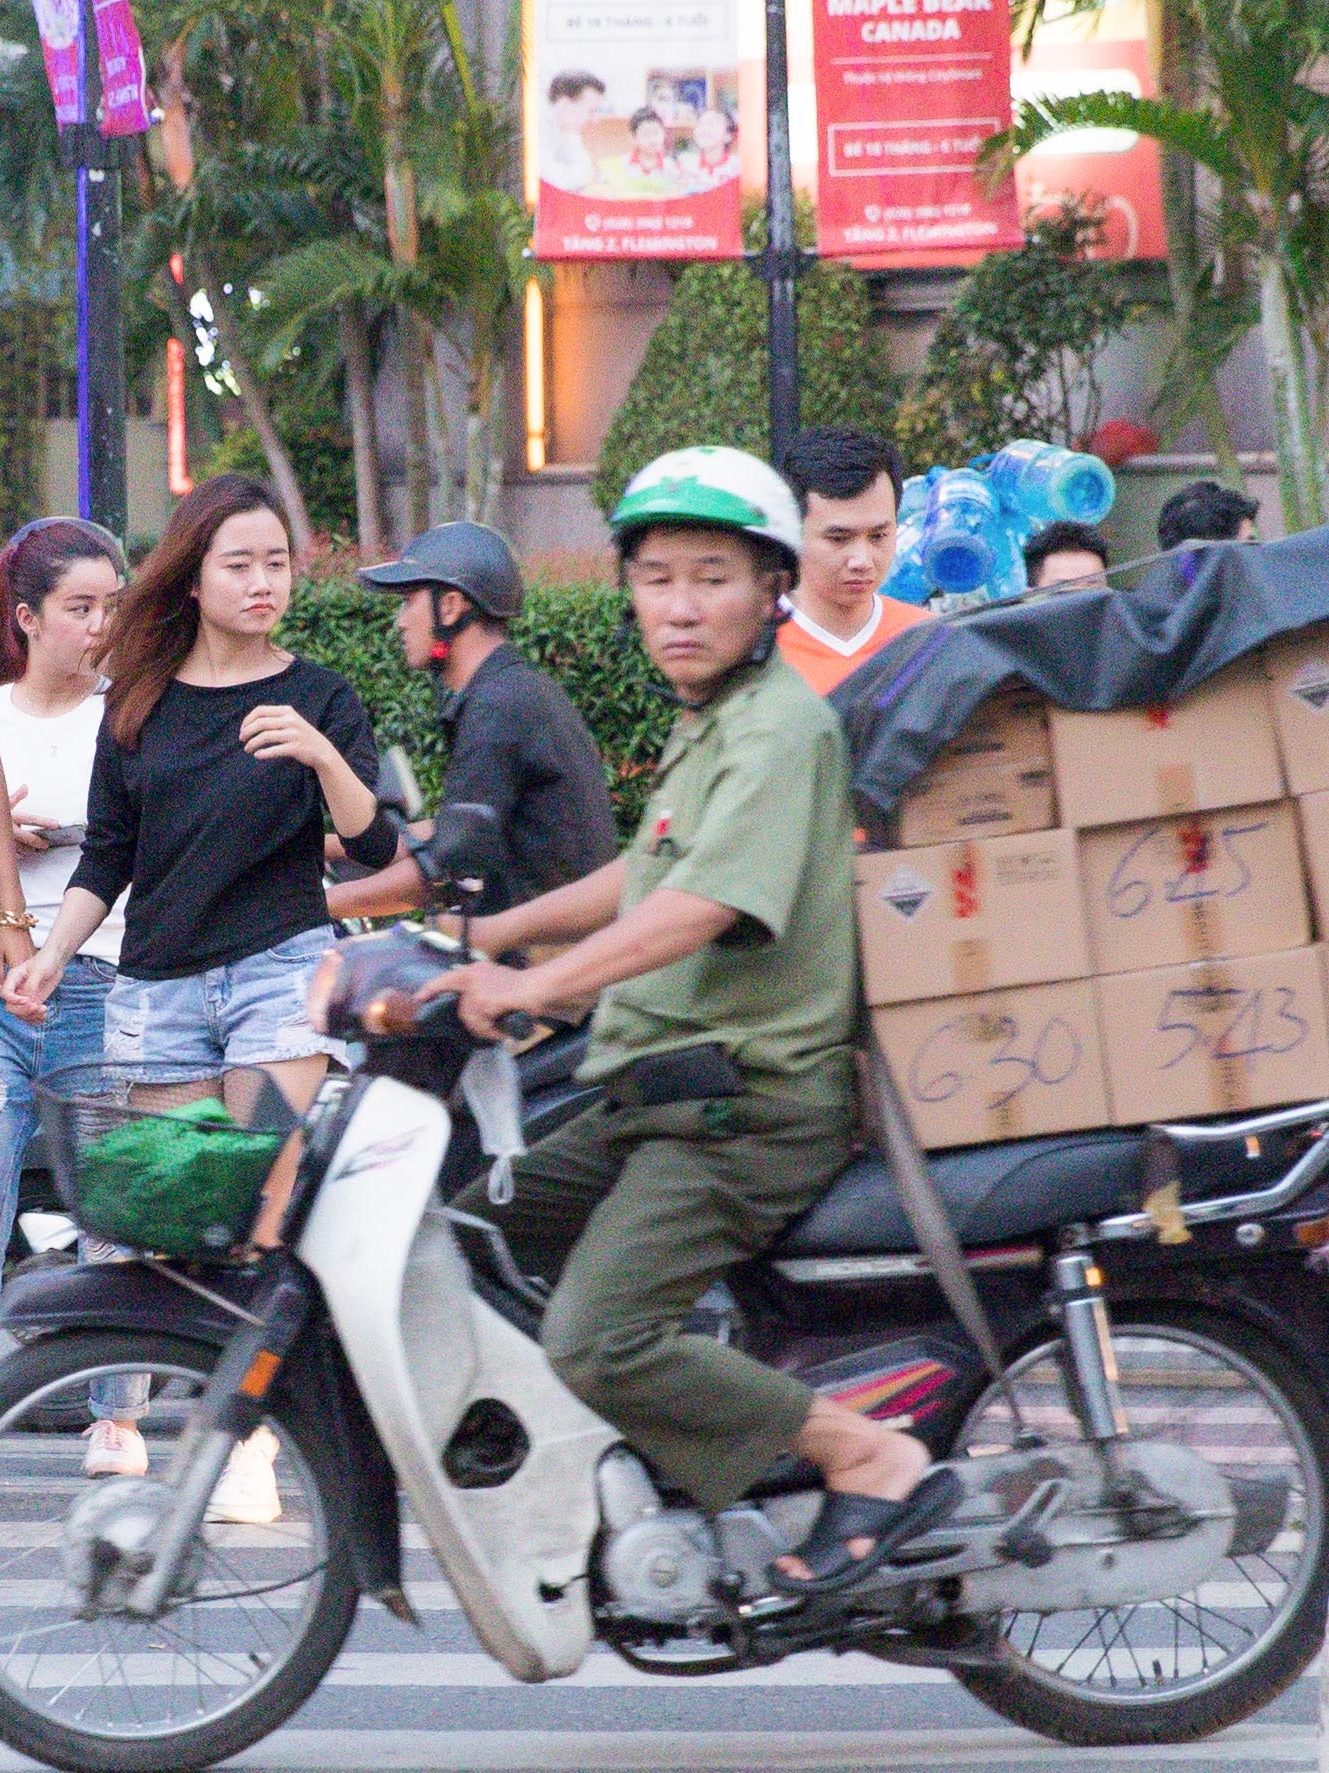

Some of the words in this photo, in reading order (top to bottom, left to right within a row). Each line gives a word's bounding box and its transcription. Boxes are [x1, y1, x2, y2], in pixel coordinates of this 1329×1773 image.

[860, 18, 962, 43] CANADA
[1105, 822, 1268, 918] 625
[908, 1012, 1084, 1111] 630
[1156, 986, 1310, 1074] 543
